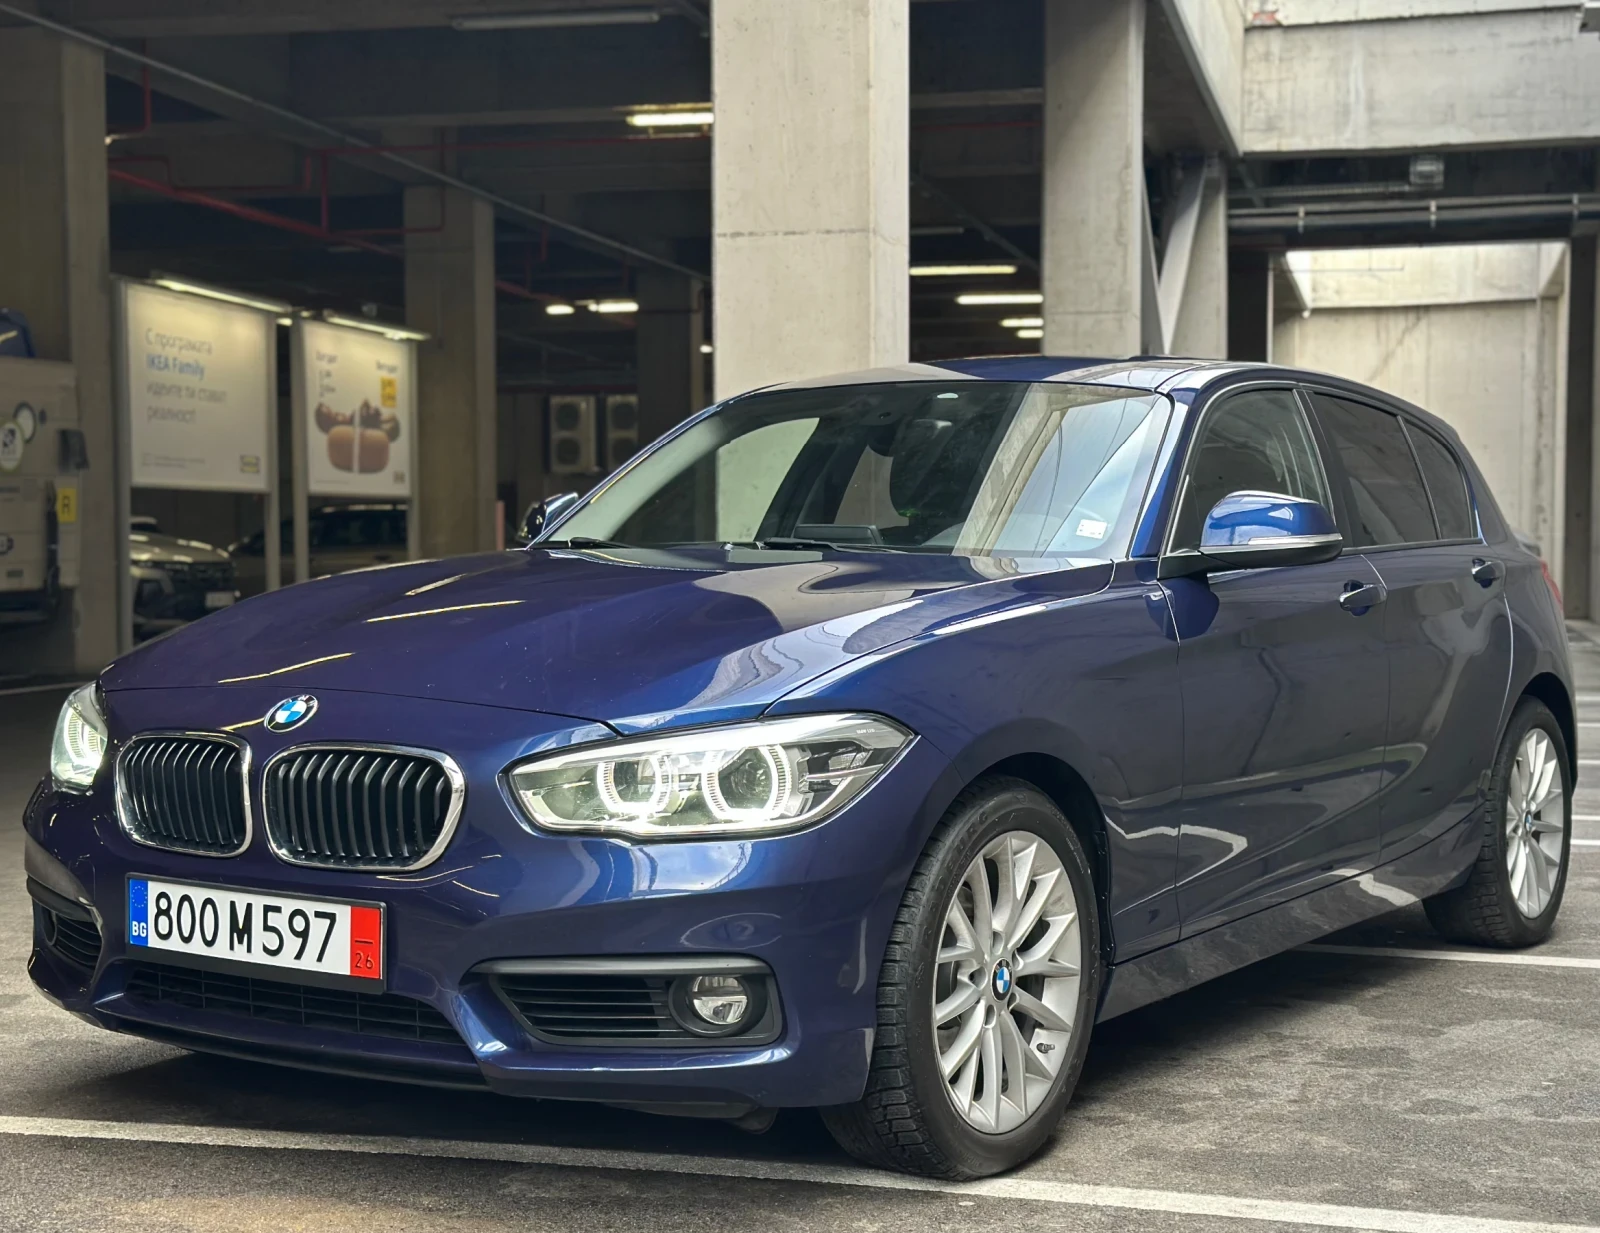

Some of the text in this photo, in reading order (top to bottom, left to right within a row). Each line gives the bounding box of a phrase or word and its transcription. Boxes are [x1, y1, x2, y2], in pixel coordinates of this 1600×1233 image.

[146, 353, 205, 380] IKEA Family
[132, 921, 147, 937] BG
[154, 891, 337, 963] 800 M 597
[354, 952, 374, 969] 26
